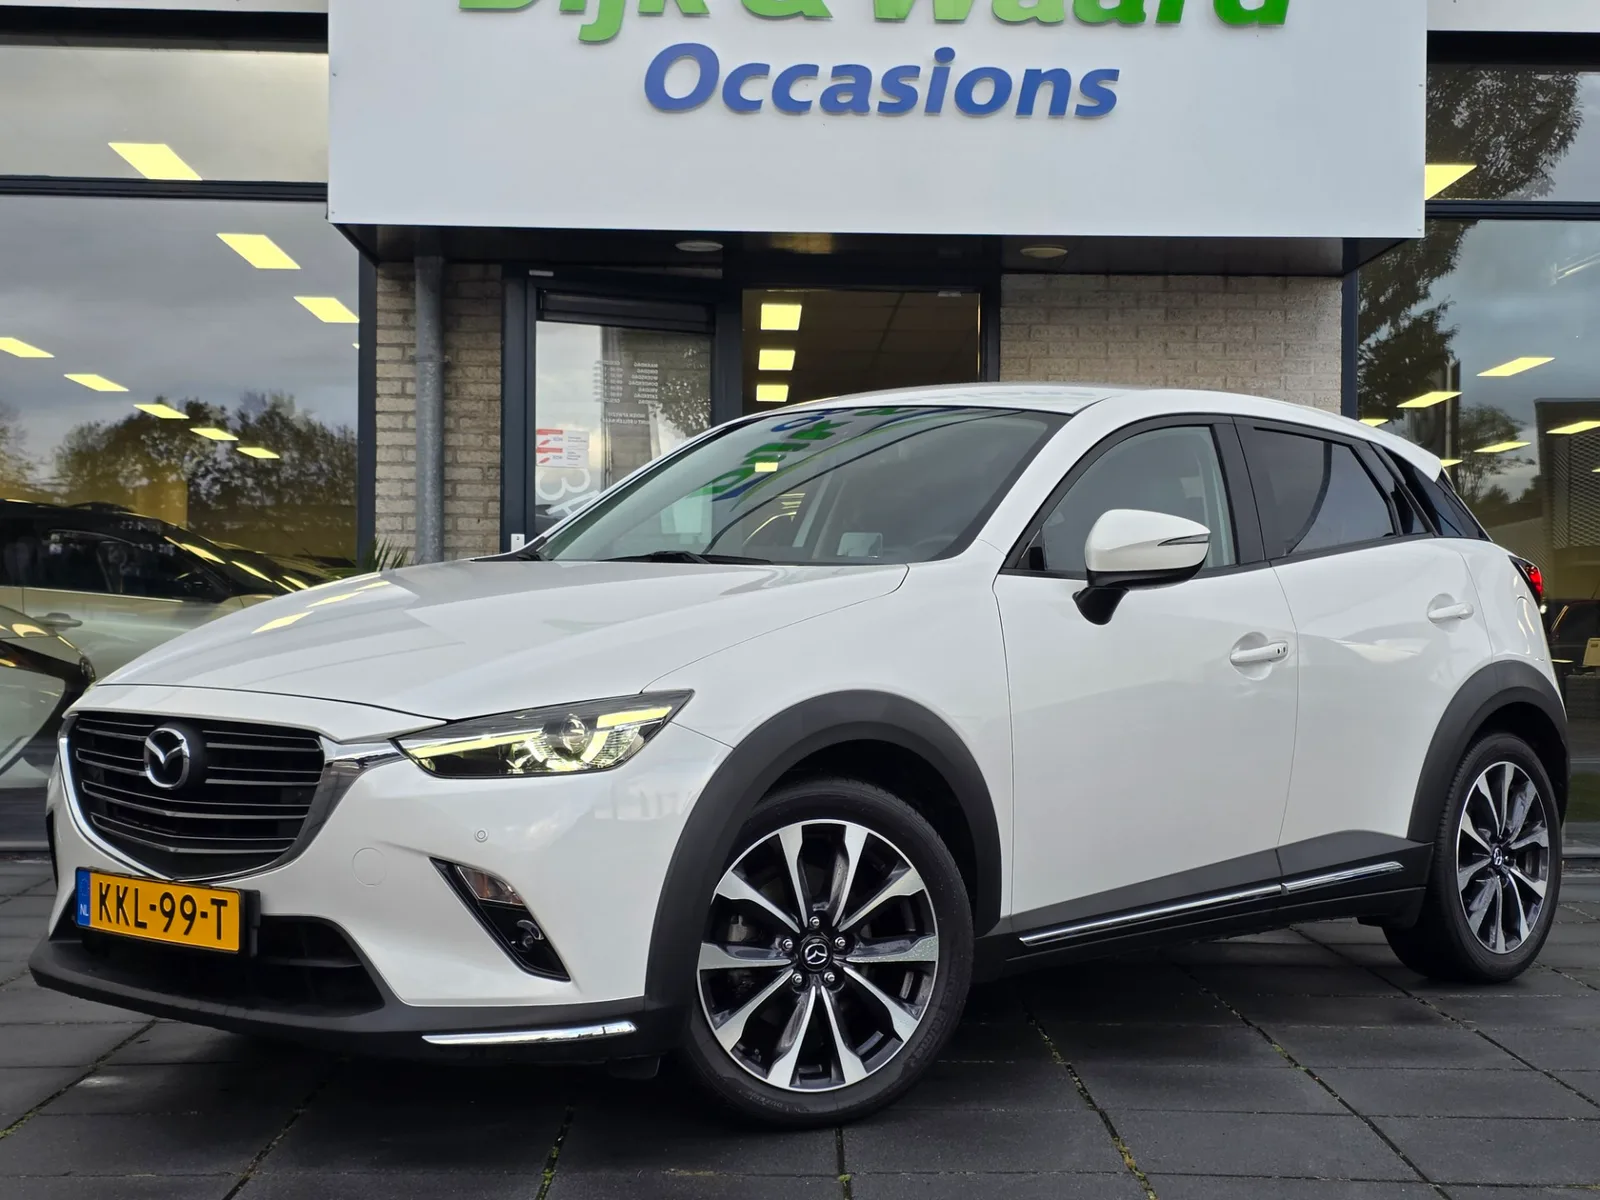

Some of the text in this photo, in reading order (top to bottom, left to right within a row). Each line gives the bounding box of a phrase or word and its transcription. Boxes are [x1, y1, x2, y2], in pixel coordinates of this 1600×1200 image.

[644, 43, 1121, 119] Occasions
[79, 882, 228, 941] NL KKL-99-T
